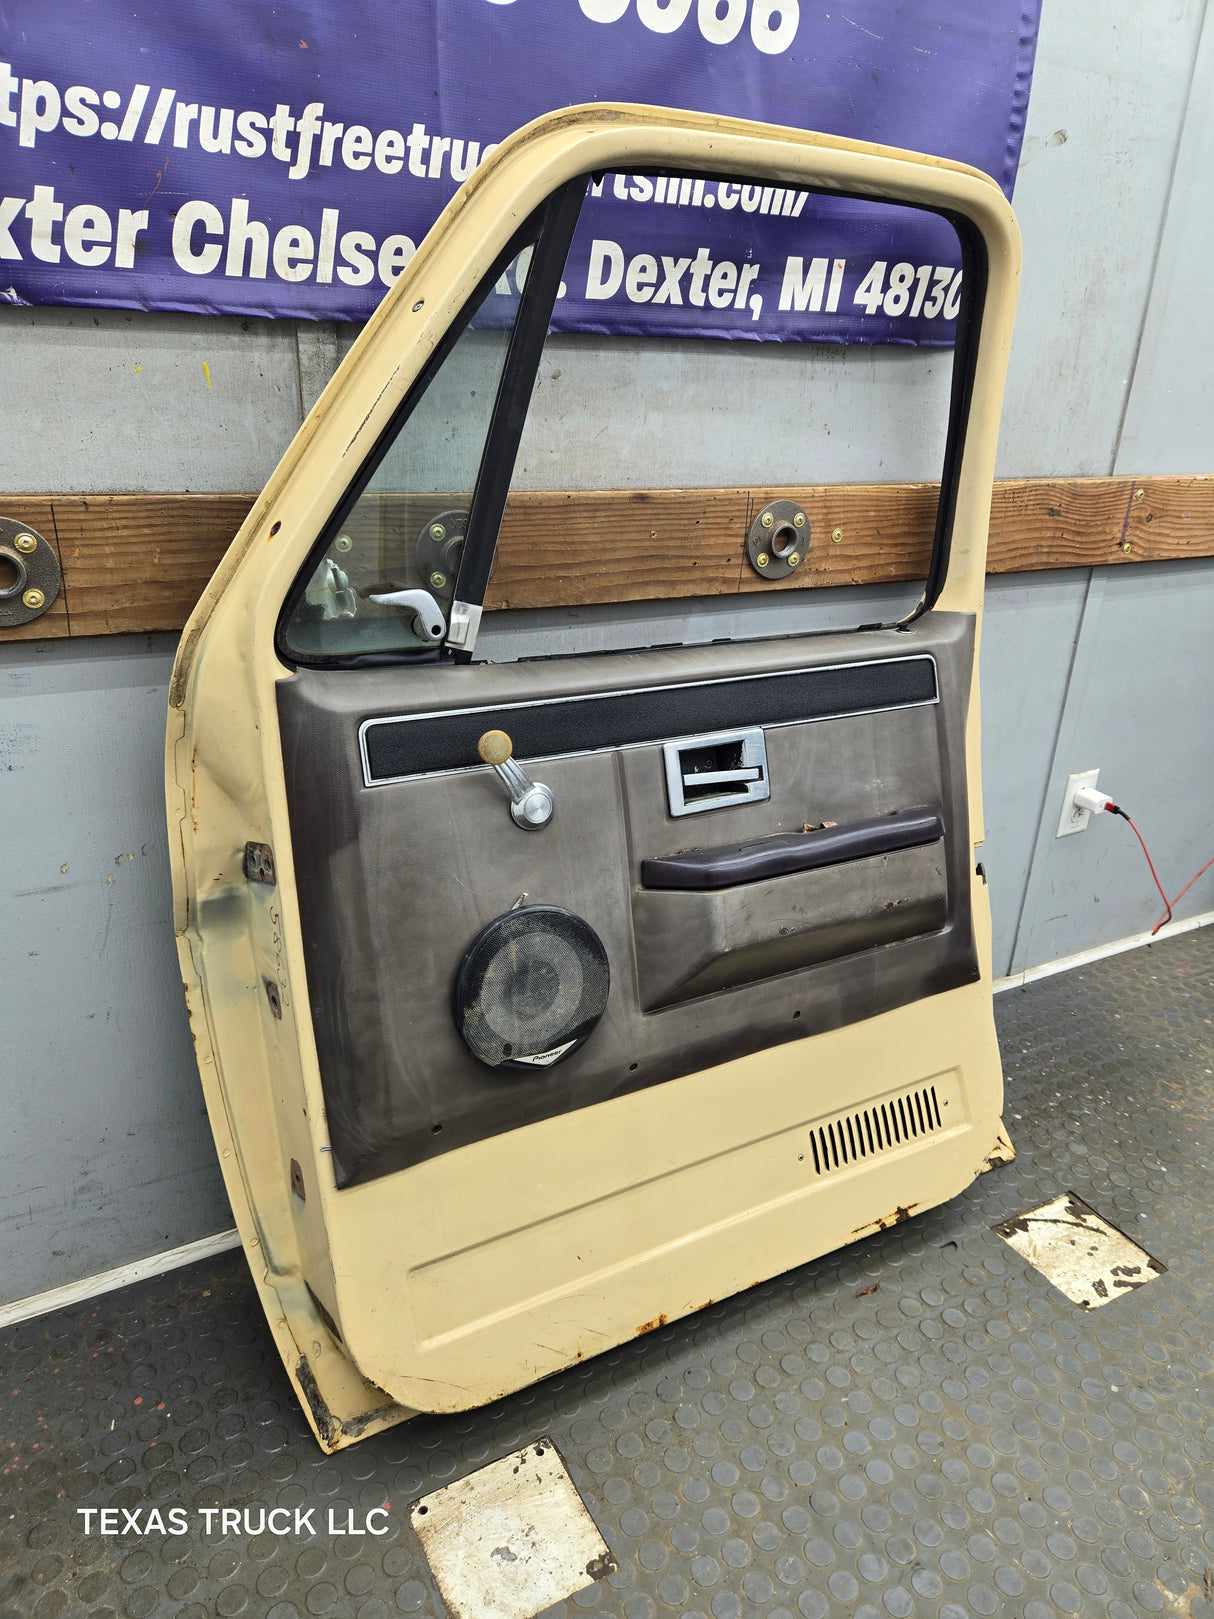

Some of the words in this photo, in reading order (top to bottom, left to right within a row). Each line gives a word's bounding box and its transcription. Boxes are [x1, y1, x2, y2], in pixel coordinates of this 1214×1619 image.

[585, 239, 762, 320] Dexter,
[778, 256, 846, 312] MI
[532, 1050, 562, 1062] Pioneer
